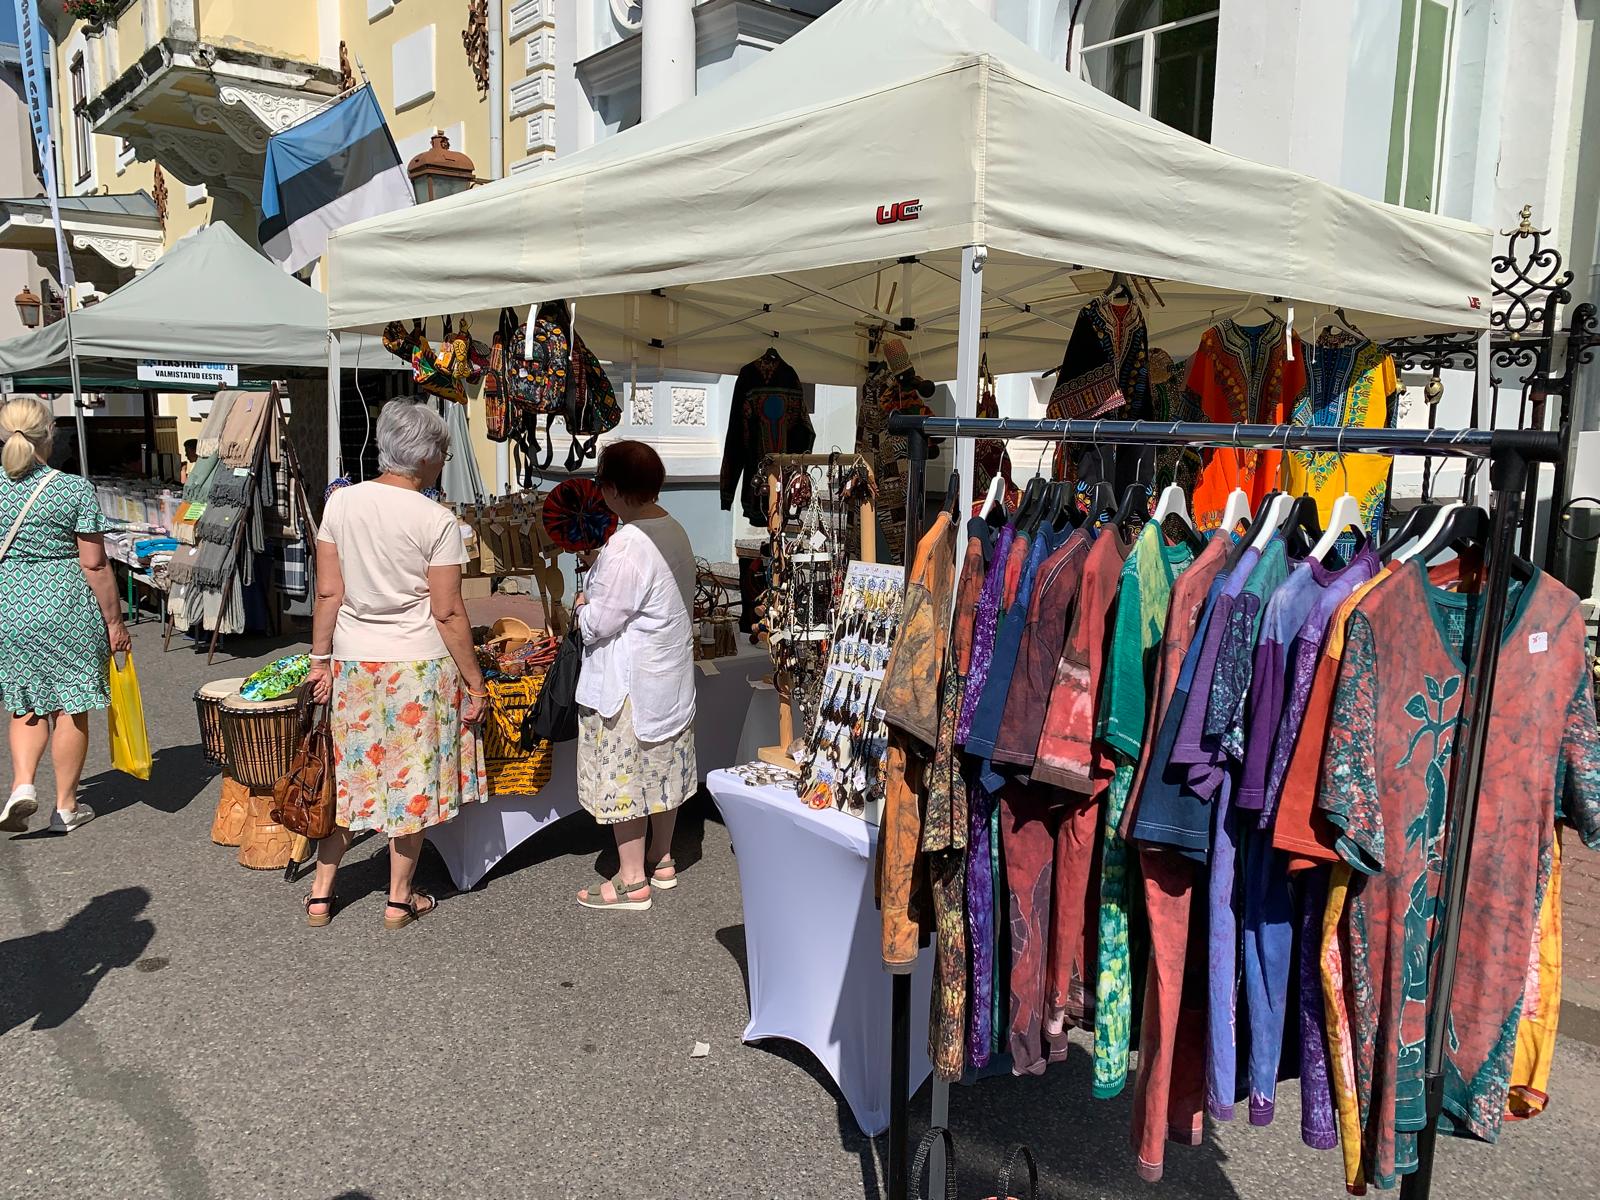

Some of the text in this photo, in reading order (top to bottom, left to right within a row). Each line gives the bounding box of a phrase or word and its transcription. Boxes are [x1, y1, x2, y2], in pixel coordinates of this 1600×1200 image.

[876, 199, 924, 225] UC RENT
[155, 370, 223, 381] VALMISTATUD EESTIS
